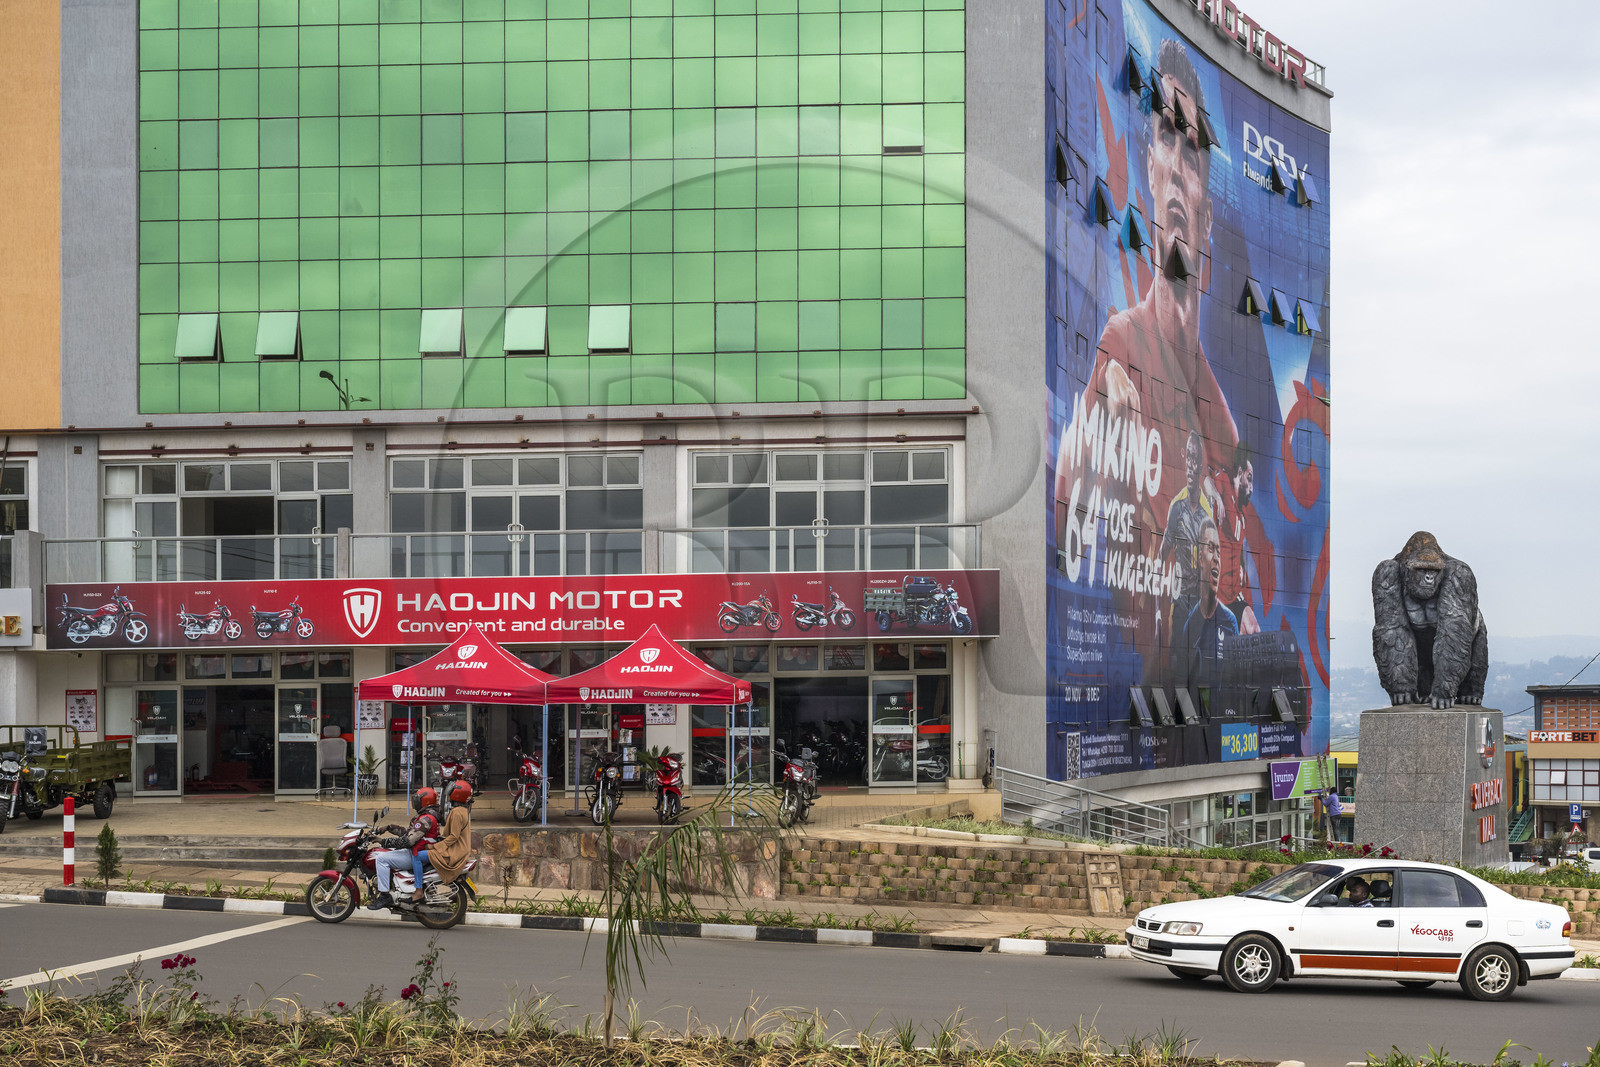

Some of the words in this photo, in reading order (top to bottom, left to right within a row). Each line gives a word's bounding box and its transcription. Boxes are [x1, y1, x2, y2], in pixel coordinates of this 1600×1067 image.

[1103, 497, 1136, 543] YOSE
[1065, 477, 1101, 588] 64
[397, 591, 536, 612] HAOJIN
[550, 589, 683, 610] MOTOR
[397, 618, 506, 633] Convenient
[511, 618, 546, 632] and
[550, 618, 625, 632] durable
[435, 662, 488, 670] HAOJIN
[620, 665, 673, 673] HAOJIN
[404, 687, 446, 697] HAOJIN
[591, 689, 633, 699] HAOJIN
[1065, 686, 1071, 702] 20
[1072, 687, 1082, 702] NOV
[1091, 687, 1100, 702] DEC
[1222, 736, 1231, 746] RWF
[1231, 732, 1258, 757] 36,300
[1472, 778, 1503, 810] SILVERBACK
[1573, 805, 1578, 814] P
[1480, 815, 1496, 844] MALL
[1410, 924, 1454, 937] YEGOCABS
